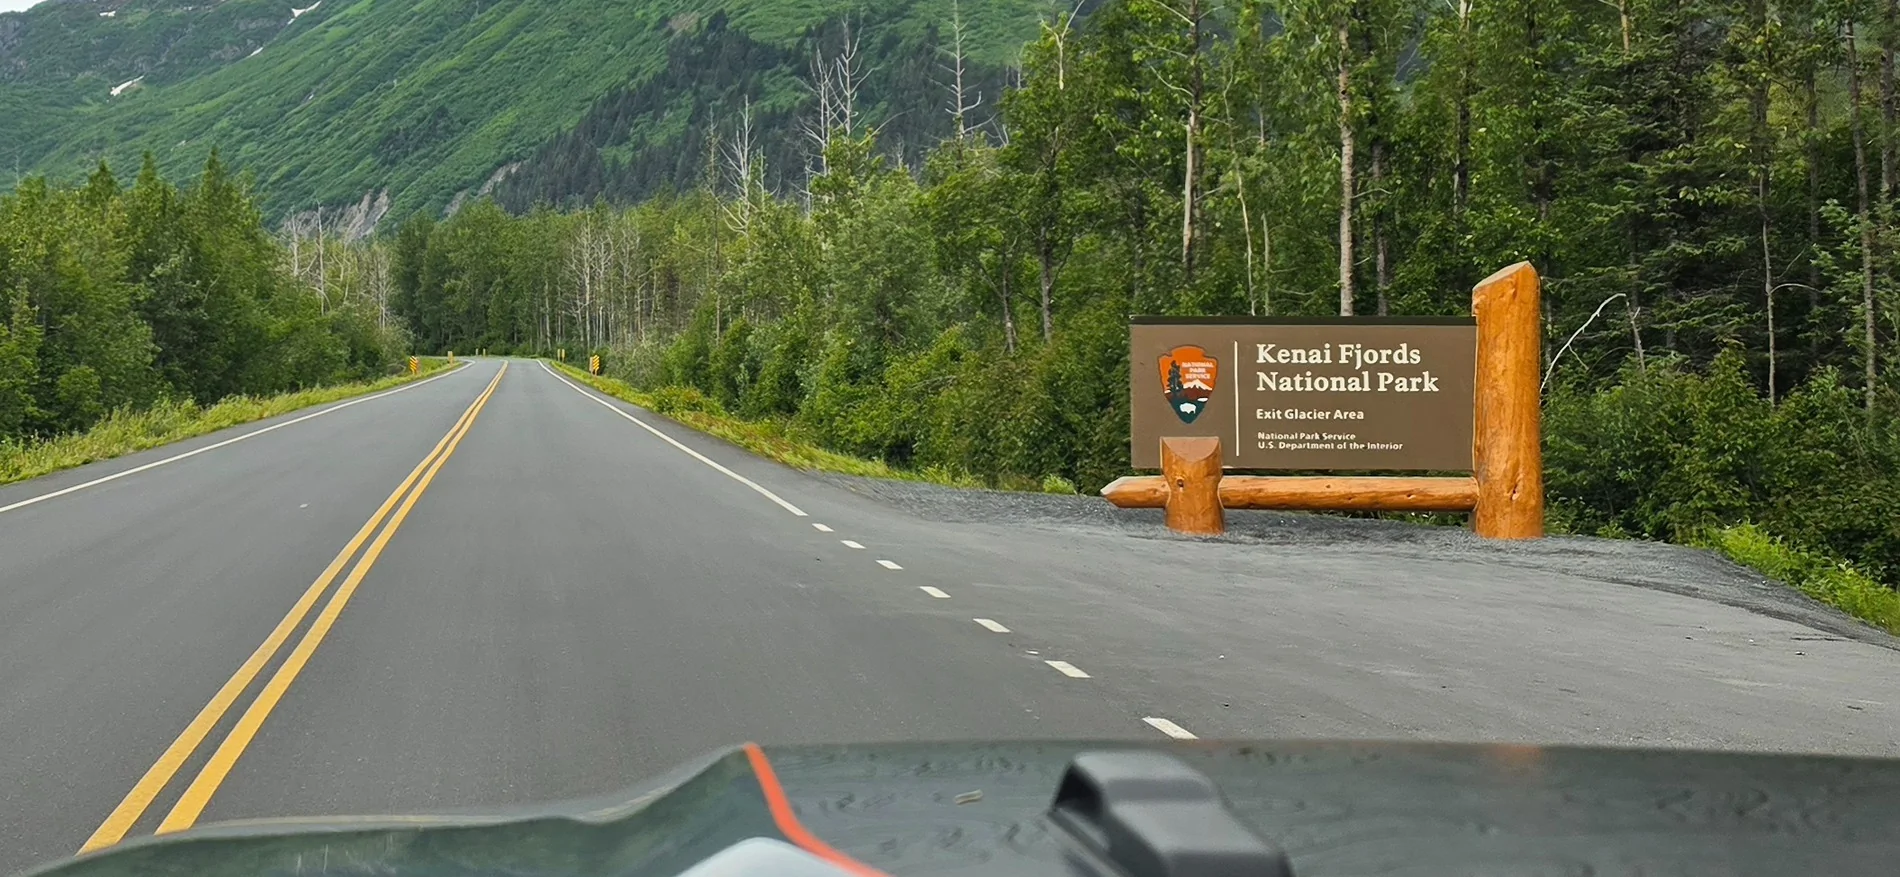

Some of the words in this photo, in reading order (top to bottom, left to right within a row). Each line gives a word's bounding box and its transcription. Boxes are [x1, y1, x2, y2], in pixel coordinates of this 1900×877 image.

[1256, 342, 1333, 364] Kenai
[1338, 342, 1421, 369] Fjords
[1256, 370, 1372, 392] National
[1376, 370, 1440, 393] Park
[1256, 408, 1282, 420] Exit
[1284, 408, 1331, 420] Glacier
[1333, 409, 1364, 420] Area
[1257, 431, 1298, 440] National
[1299, 432, 1320, 440] Park
[1321, 432, 1356, 441] Service
[1257, 441, 1276, 450] U.S.
[1278, 441, 1335, 451] Department
[1336, 442, 1347, 450] of
[1349, 442, 1366, 450] the
[1367, 442, 1404, 451] Interior
